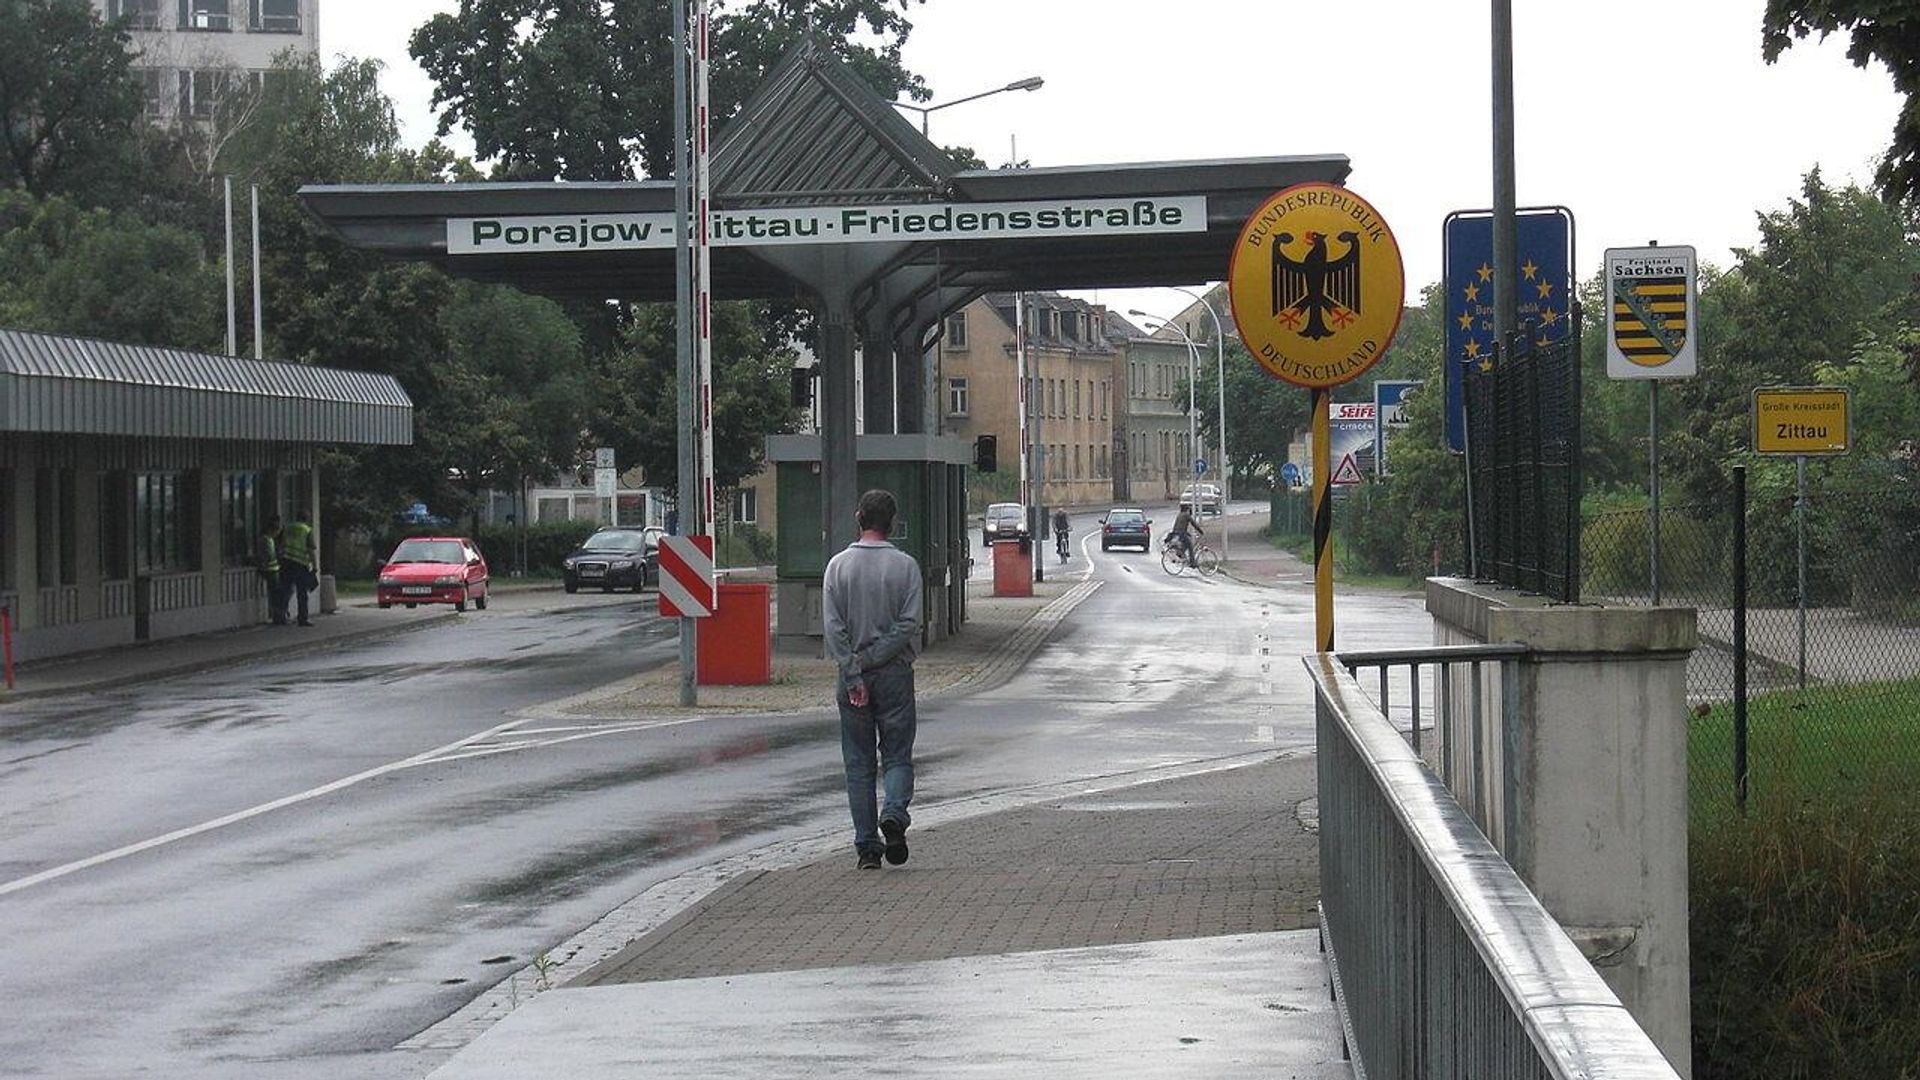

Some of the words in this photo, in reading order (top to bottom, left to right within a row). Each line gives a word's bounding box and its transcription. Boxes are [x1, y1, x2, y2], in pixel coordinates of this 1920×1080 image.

[472, 218, 653, 248] Porajow
[841, 201, 1183, 235] Friedensstraße
[1248, 192, 1386, 247] BUNDESREPUBLIK
[1615, 265, 1685, 276] Sachsen
[1261, 340, 1378, 380] DEUTSCHLAND
[1777, 423, 1828, 439] Zittau
